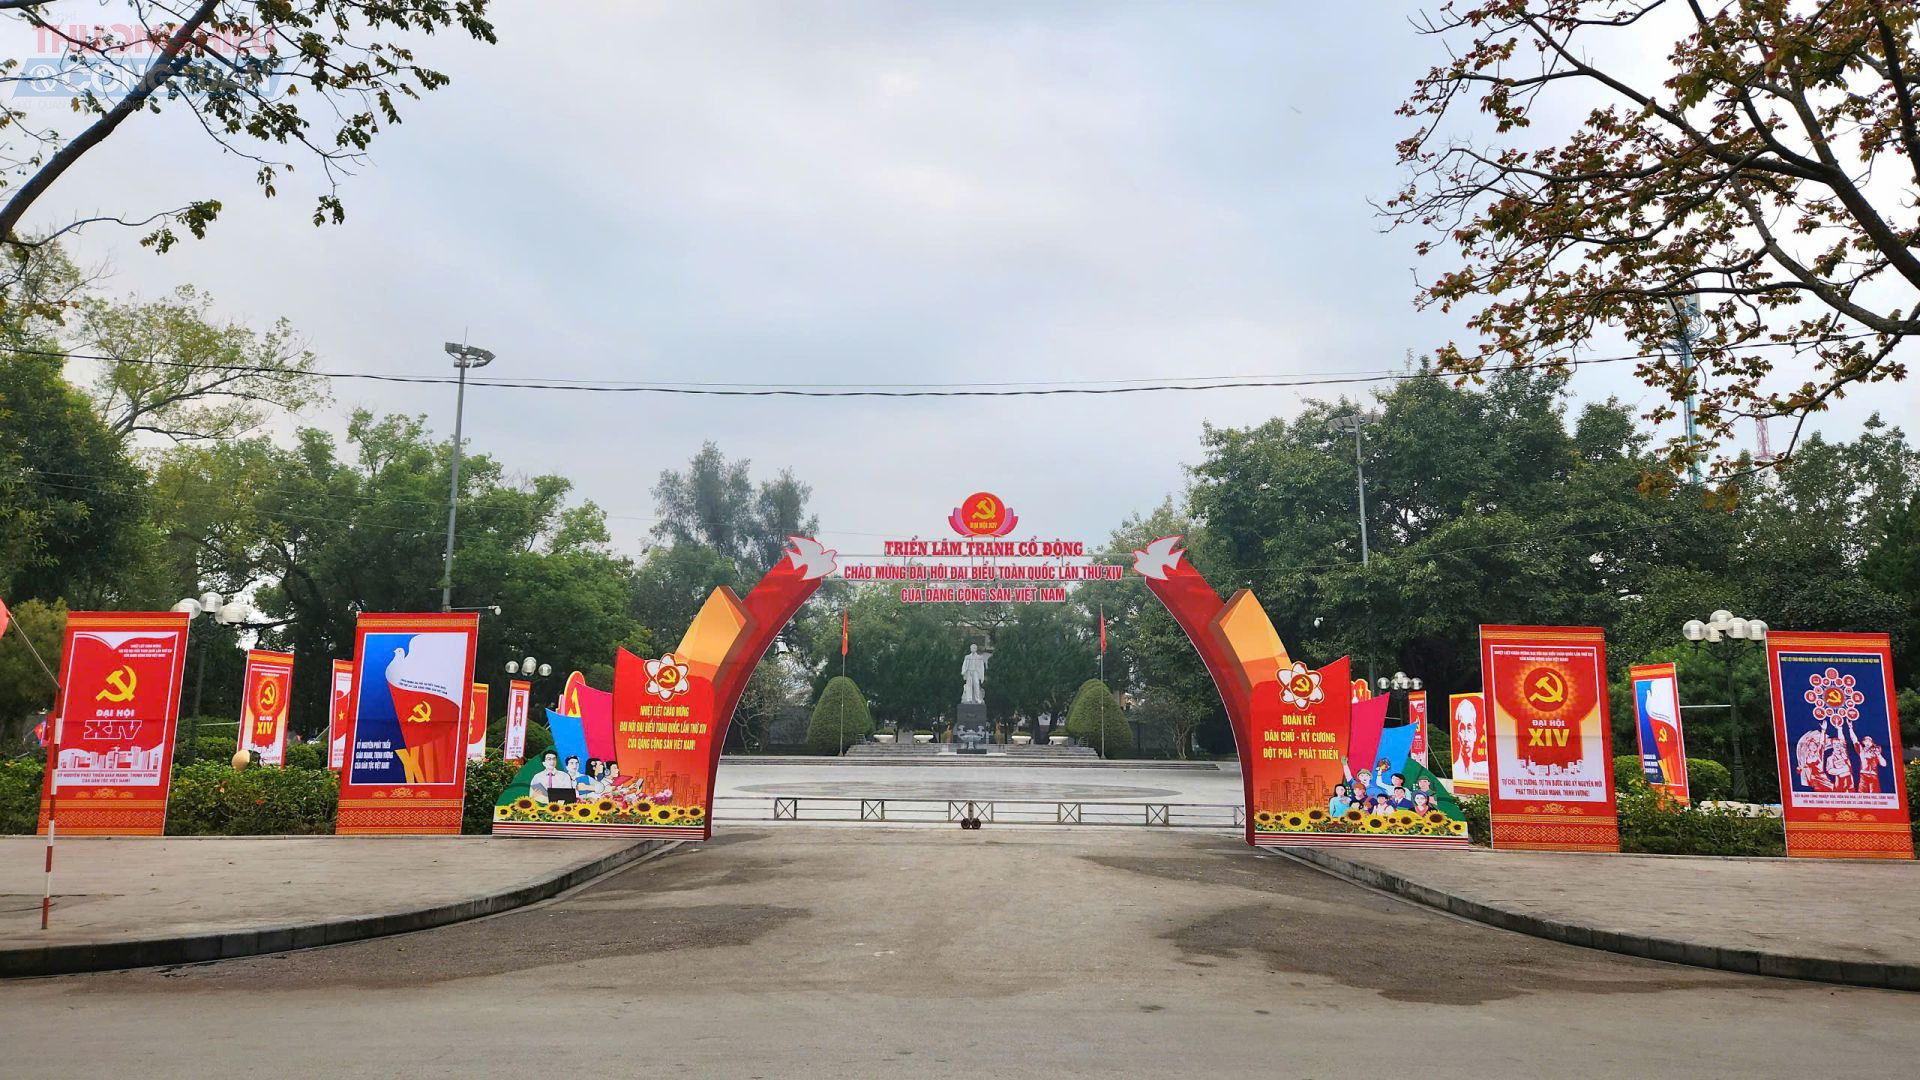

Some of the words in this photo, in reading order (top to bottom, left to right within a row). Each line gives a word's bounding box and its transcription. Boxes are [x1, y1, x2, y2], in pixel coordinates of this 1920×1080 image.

[884, 535, 928, 556] TRIỂN
[966, 542, 1015, 556] TRANH
[1018, 536, 1038, 556] CỔ
[1042, 538, 1084, 560] ĐỘNG
[844, 563, 872, 580] CHÀO
[876, 564, 906, 580] MỪNG
[910, 566, 926, 582] ĐẠI
[930, 563, 948, 582] HỘI
[950, 566, 968, 583] ĐẠI
[971, 561, 995, 580] BIỂU
[998, 563, 1026, 580] TOÀN
[1028, 562, 1056, 580] QUỐC
[1058, 561, 1078, 580] LẦN
[1082, 562, 1102, 580] THỨ
[1105, 566, 1123, 580] XIV
[901, 585, 922, 602] CỦA
[925, 584, 954, 602] ĐẢNG
[957, 585, 987, 605] CỘNG
[989, 584, 1010, 602] SẢN
[1014, 586, 1037, 605] VIỆT
[1040, 588, 1066, 602] NAM
[96, 709, 114, 719] ĐẠI
[116, 708, 135, 718] HỘI
[1282, 712, 1302, 725] ĐOÀN
[1304, 712, 1316, 726] KẾT
[84, 720, 142, 740] XIV
[256, 722, 273, 734] XIV
[1549, 719, 1565, 727] HỘI
[1264, 729, 1279, 741] DÂN
[1280, 729, 1295, 742] CHỦ
[1301, 729, 1310, 742] KỶ
[1312, 732, 1336, 742] CƯƠNG
[1528, 728, 1570, 747] XIV
[1263, 746, 1276, 760] ĐỘT
[1278, 746, 1292, 758] PHÁ
[1298, 746, 1316, 758] PHÁT
[1318, 746, 1339, 760] TRIỂN
